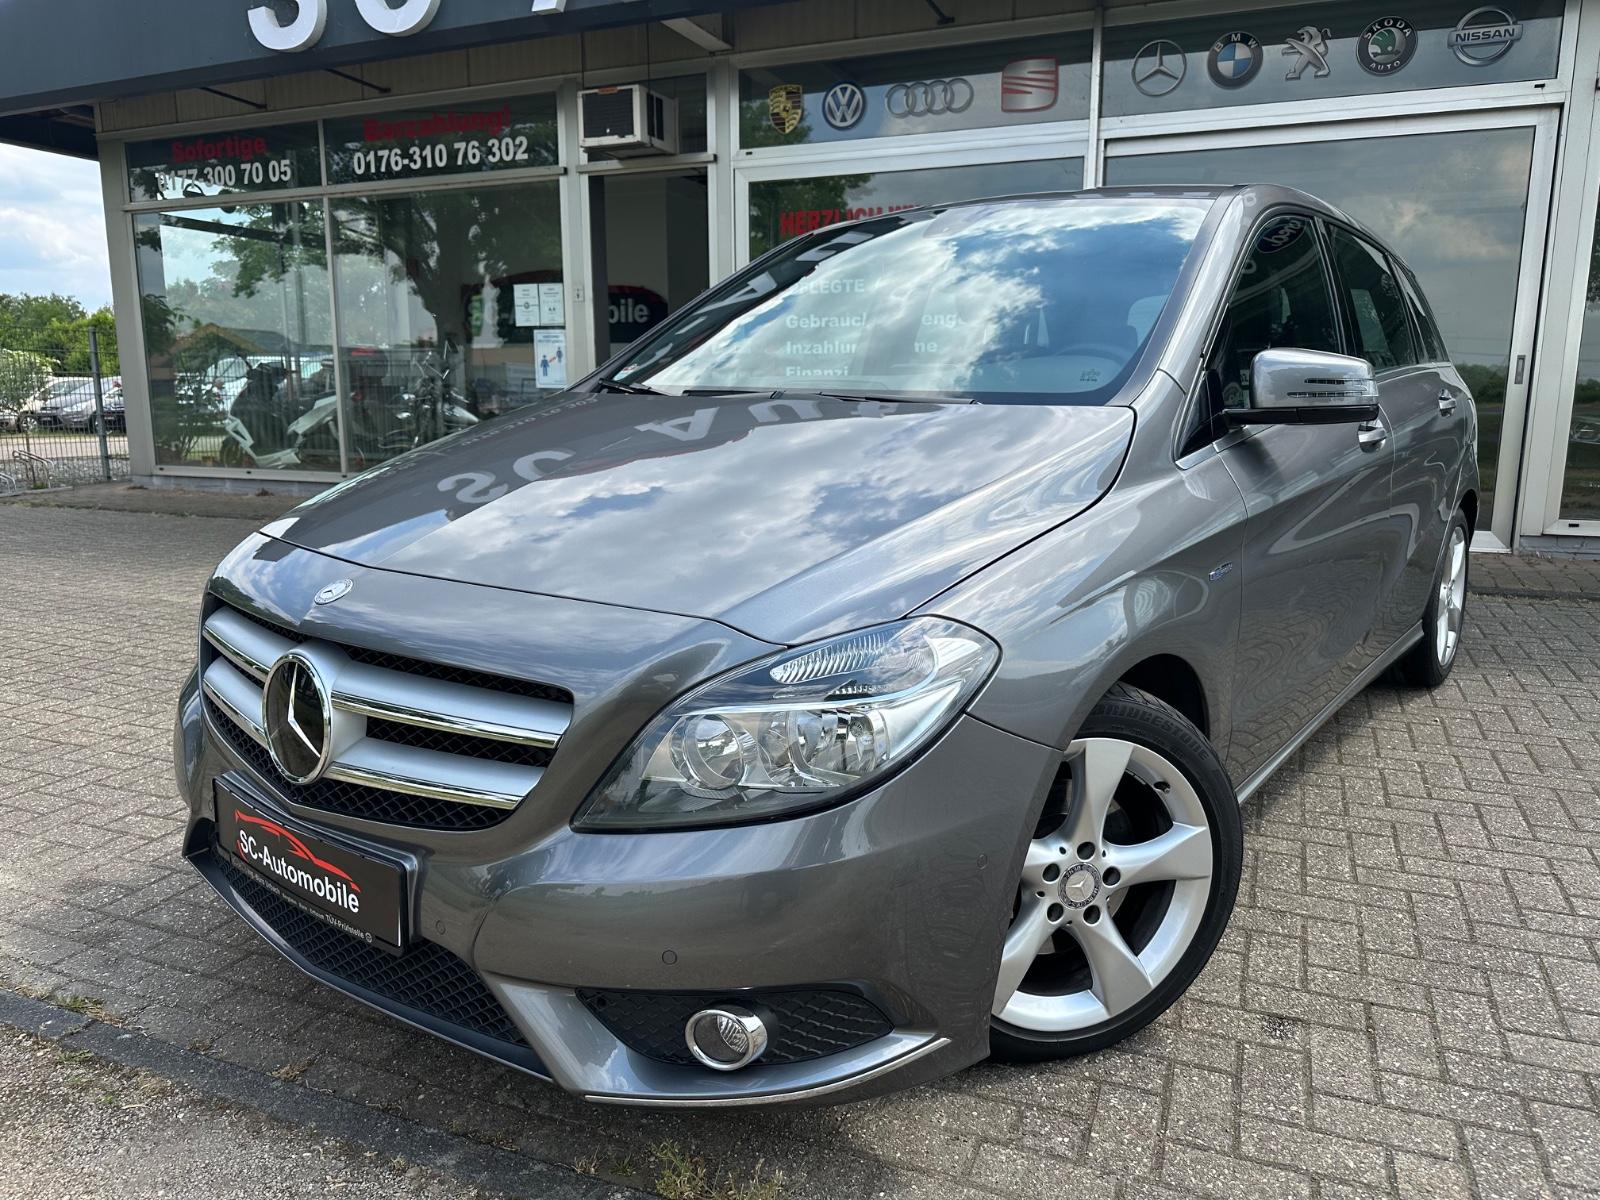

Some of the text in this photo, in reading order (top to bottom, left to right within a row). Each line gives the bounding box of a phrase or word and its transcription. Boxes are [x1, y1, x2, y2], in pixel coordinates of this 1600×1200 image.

[1363, 18, 1412, 39] SKODA
[1455, 28, 1515, 43] NISSAN
[1214, 33, 1259, 52] BMW
[1370, 60, 1401, 71] AUTO
[363, 105, 511, 142] Barzahlung!
[171, 136, 267, 163] Sofortige
[353, 136, 529, 175] 0176-310 76 302
[157, 159, 292, 192] 0177-300 70 05
[238, 829, 360, 914] SC-Automobile
